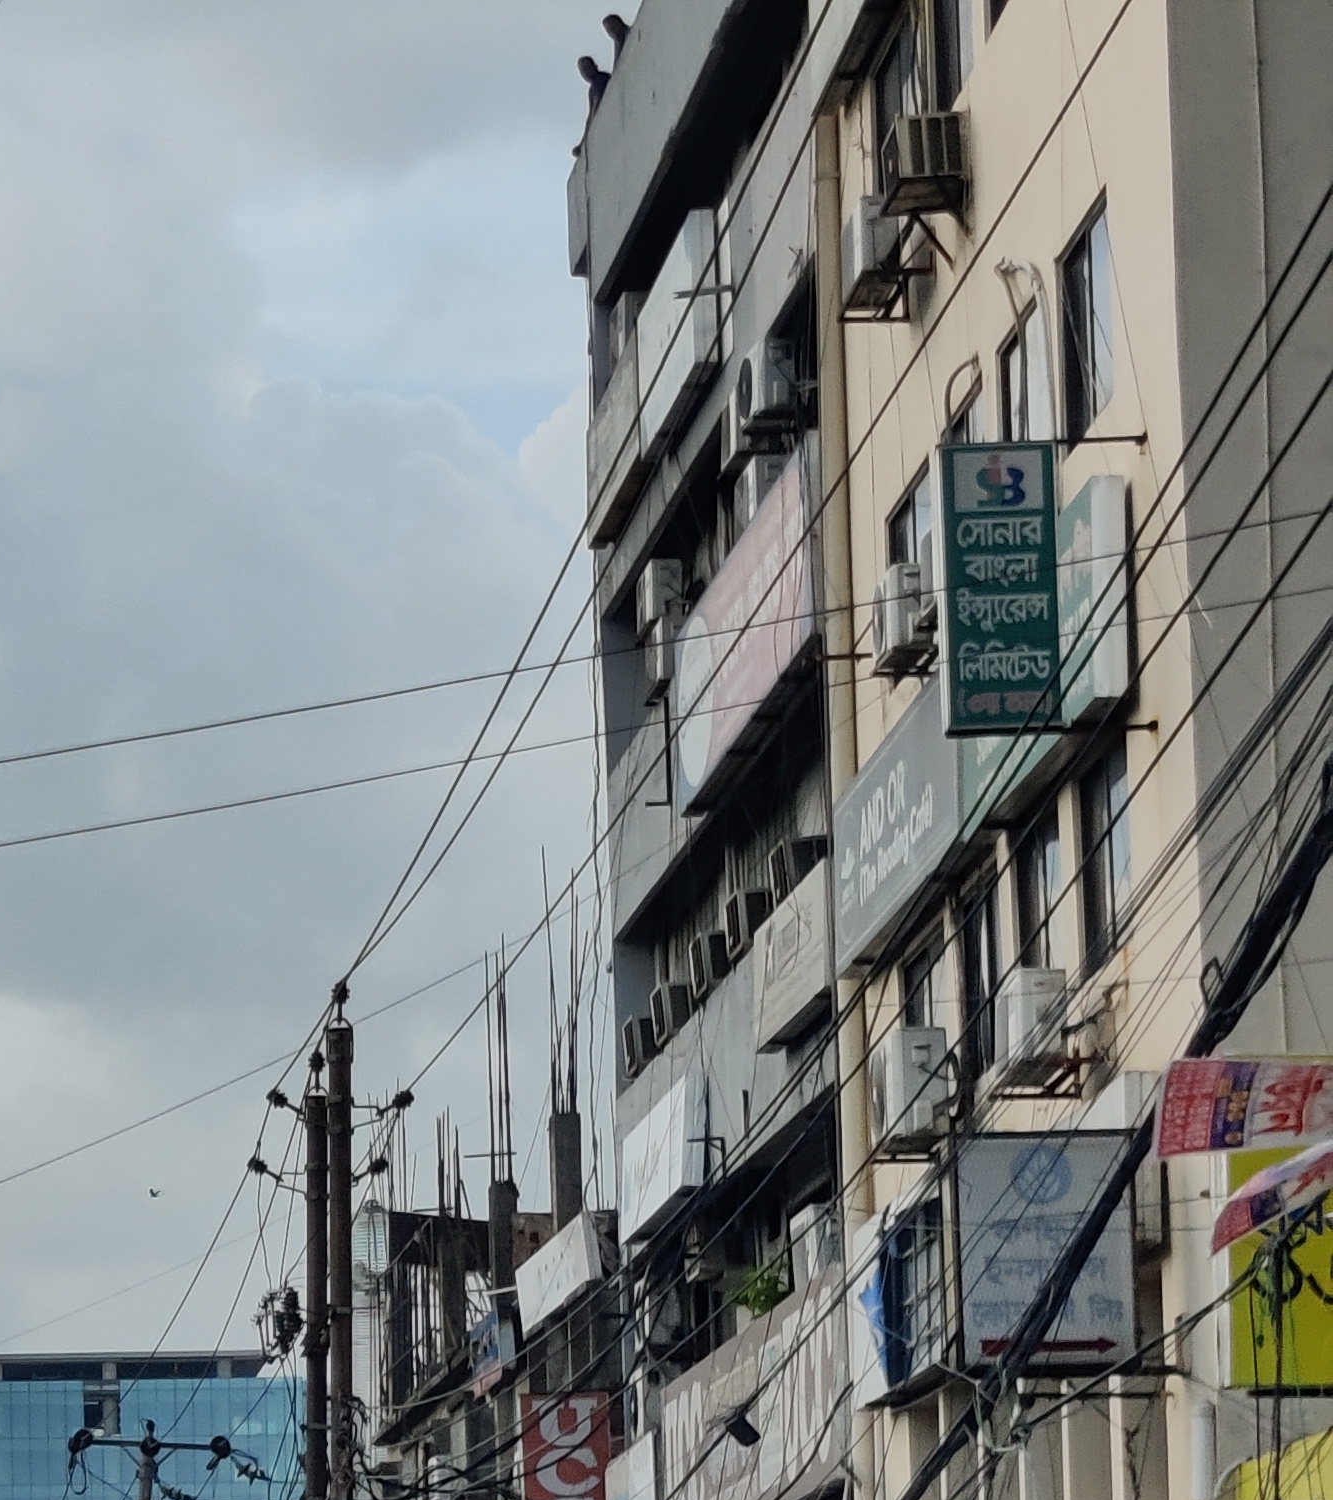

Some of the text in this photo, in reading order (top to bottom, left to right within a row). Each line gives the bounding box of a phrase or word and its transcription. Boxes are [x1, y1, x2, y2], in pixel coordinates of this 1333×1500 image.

[957, 516, 1043, 549] সোনার
[963, 553, 1039, 587] বাংলা
[958, 640, 1051, 681] লিমিটেড
[860, 760, 906, 861] AND OR
